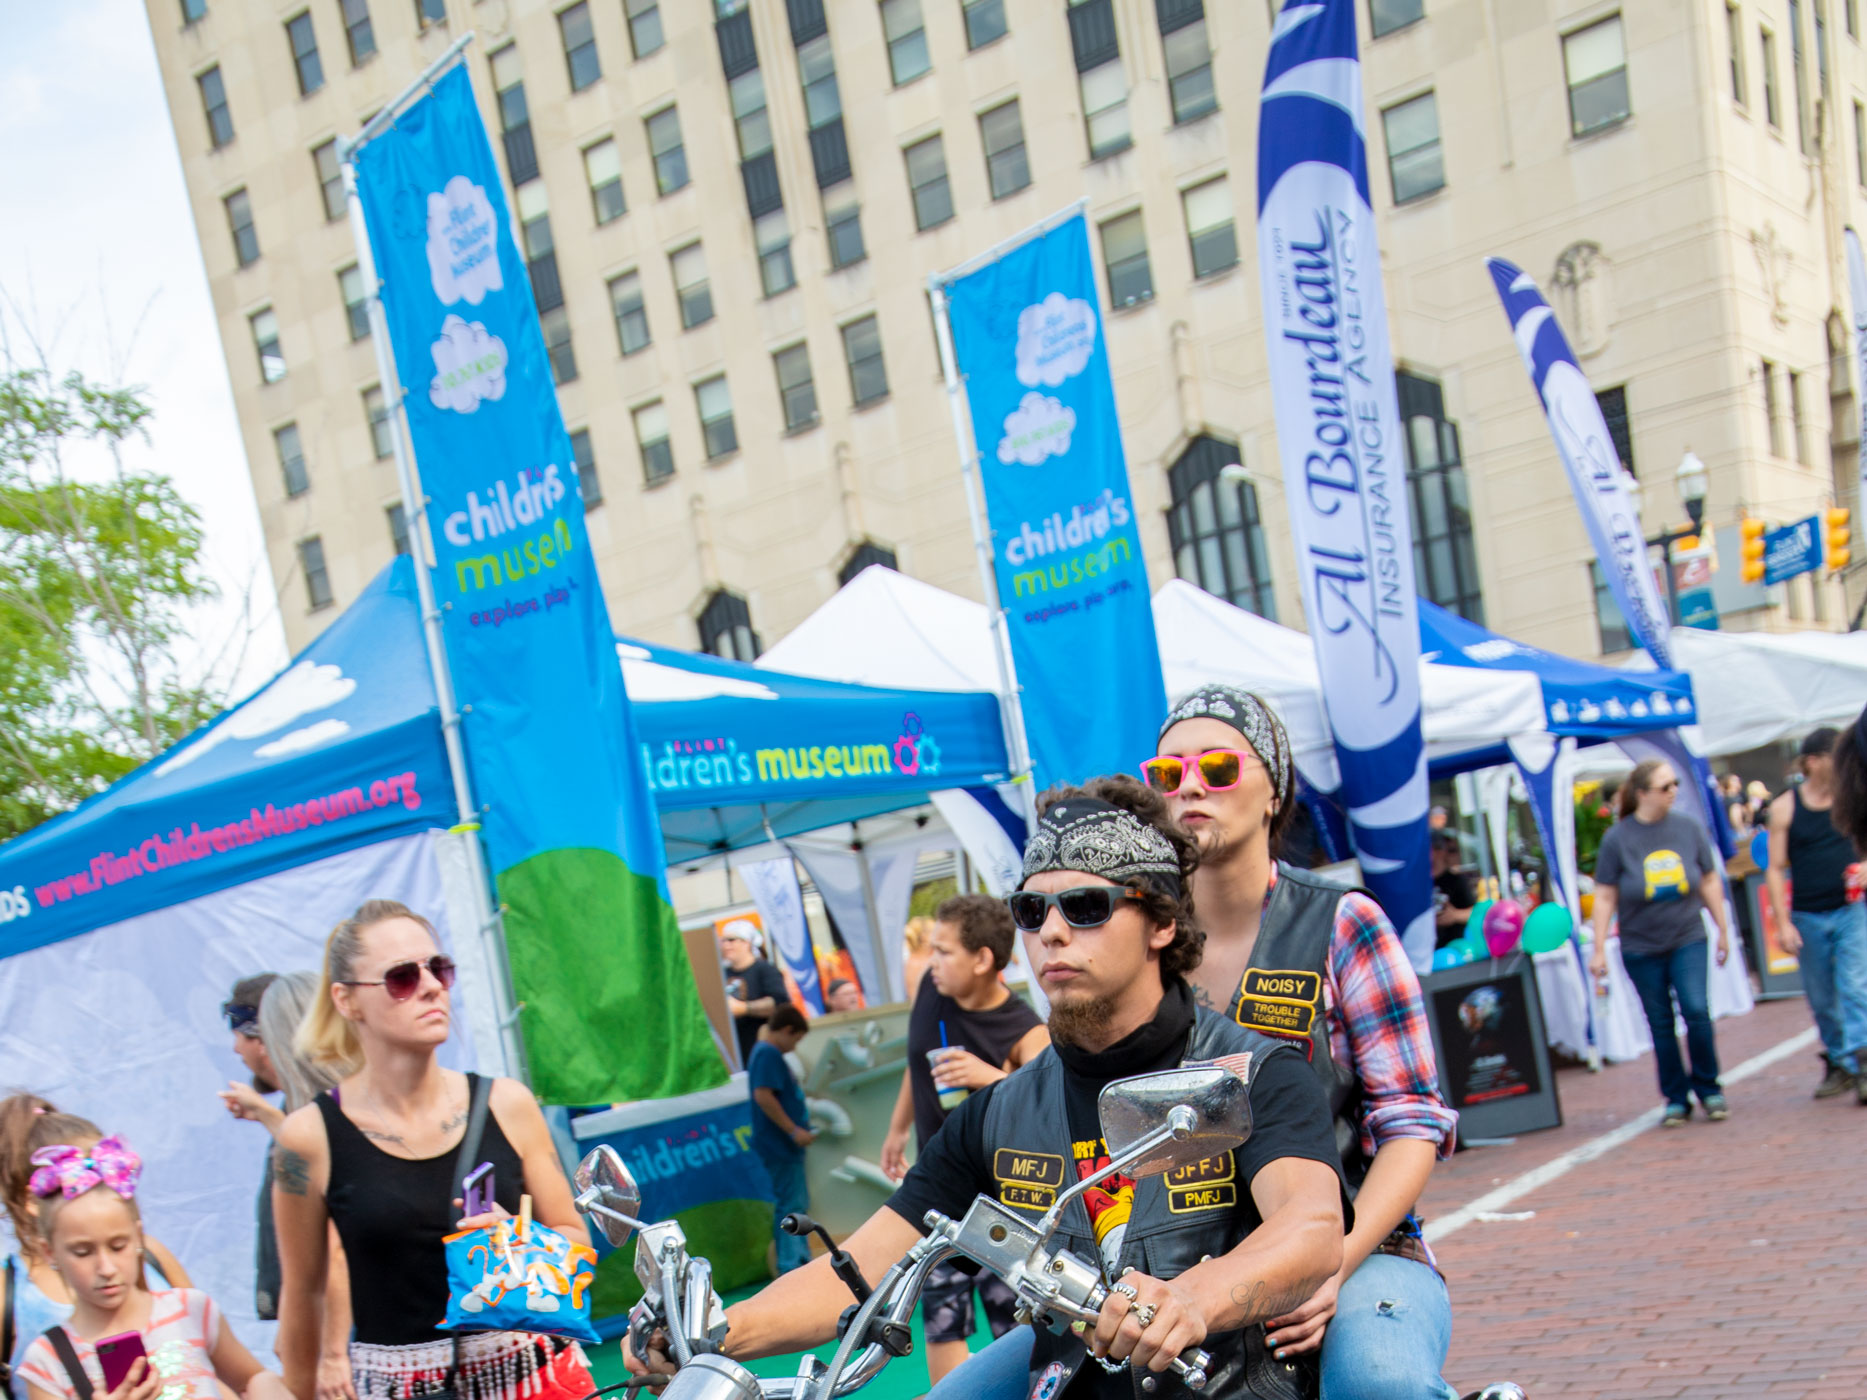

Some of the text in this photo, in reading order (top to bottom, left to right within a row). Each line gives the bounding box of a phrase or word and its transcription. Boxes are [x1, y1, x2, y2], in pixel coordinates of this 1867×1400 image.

[1336, 208, 1405, 618] INSURANCE AGENCY
[1283, 206, 1397, 706] Al Bourdeau
[756, 744, 892, 781] museum
[34, 771, 422, 907] www.FlintChildrensMuseum.org
[1256, 977, 1306, 994] NOISY
[1252, 1012, 1299, 1027] TOGETHER
[1254, 1002, 1302, 1017] TROUBLE
[1011, 1157, 1048, 1179] MFJ
[1185, 1189, 1220, 1207] PMFJ
